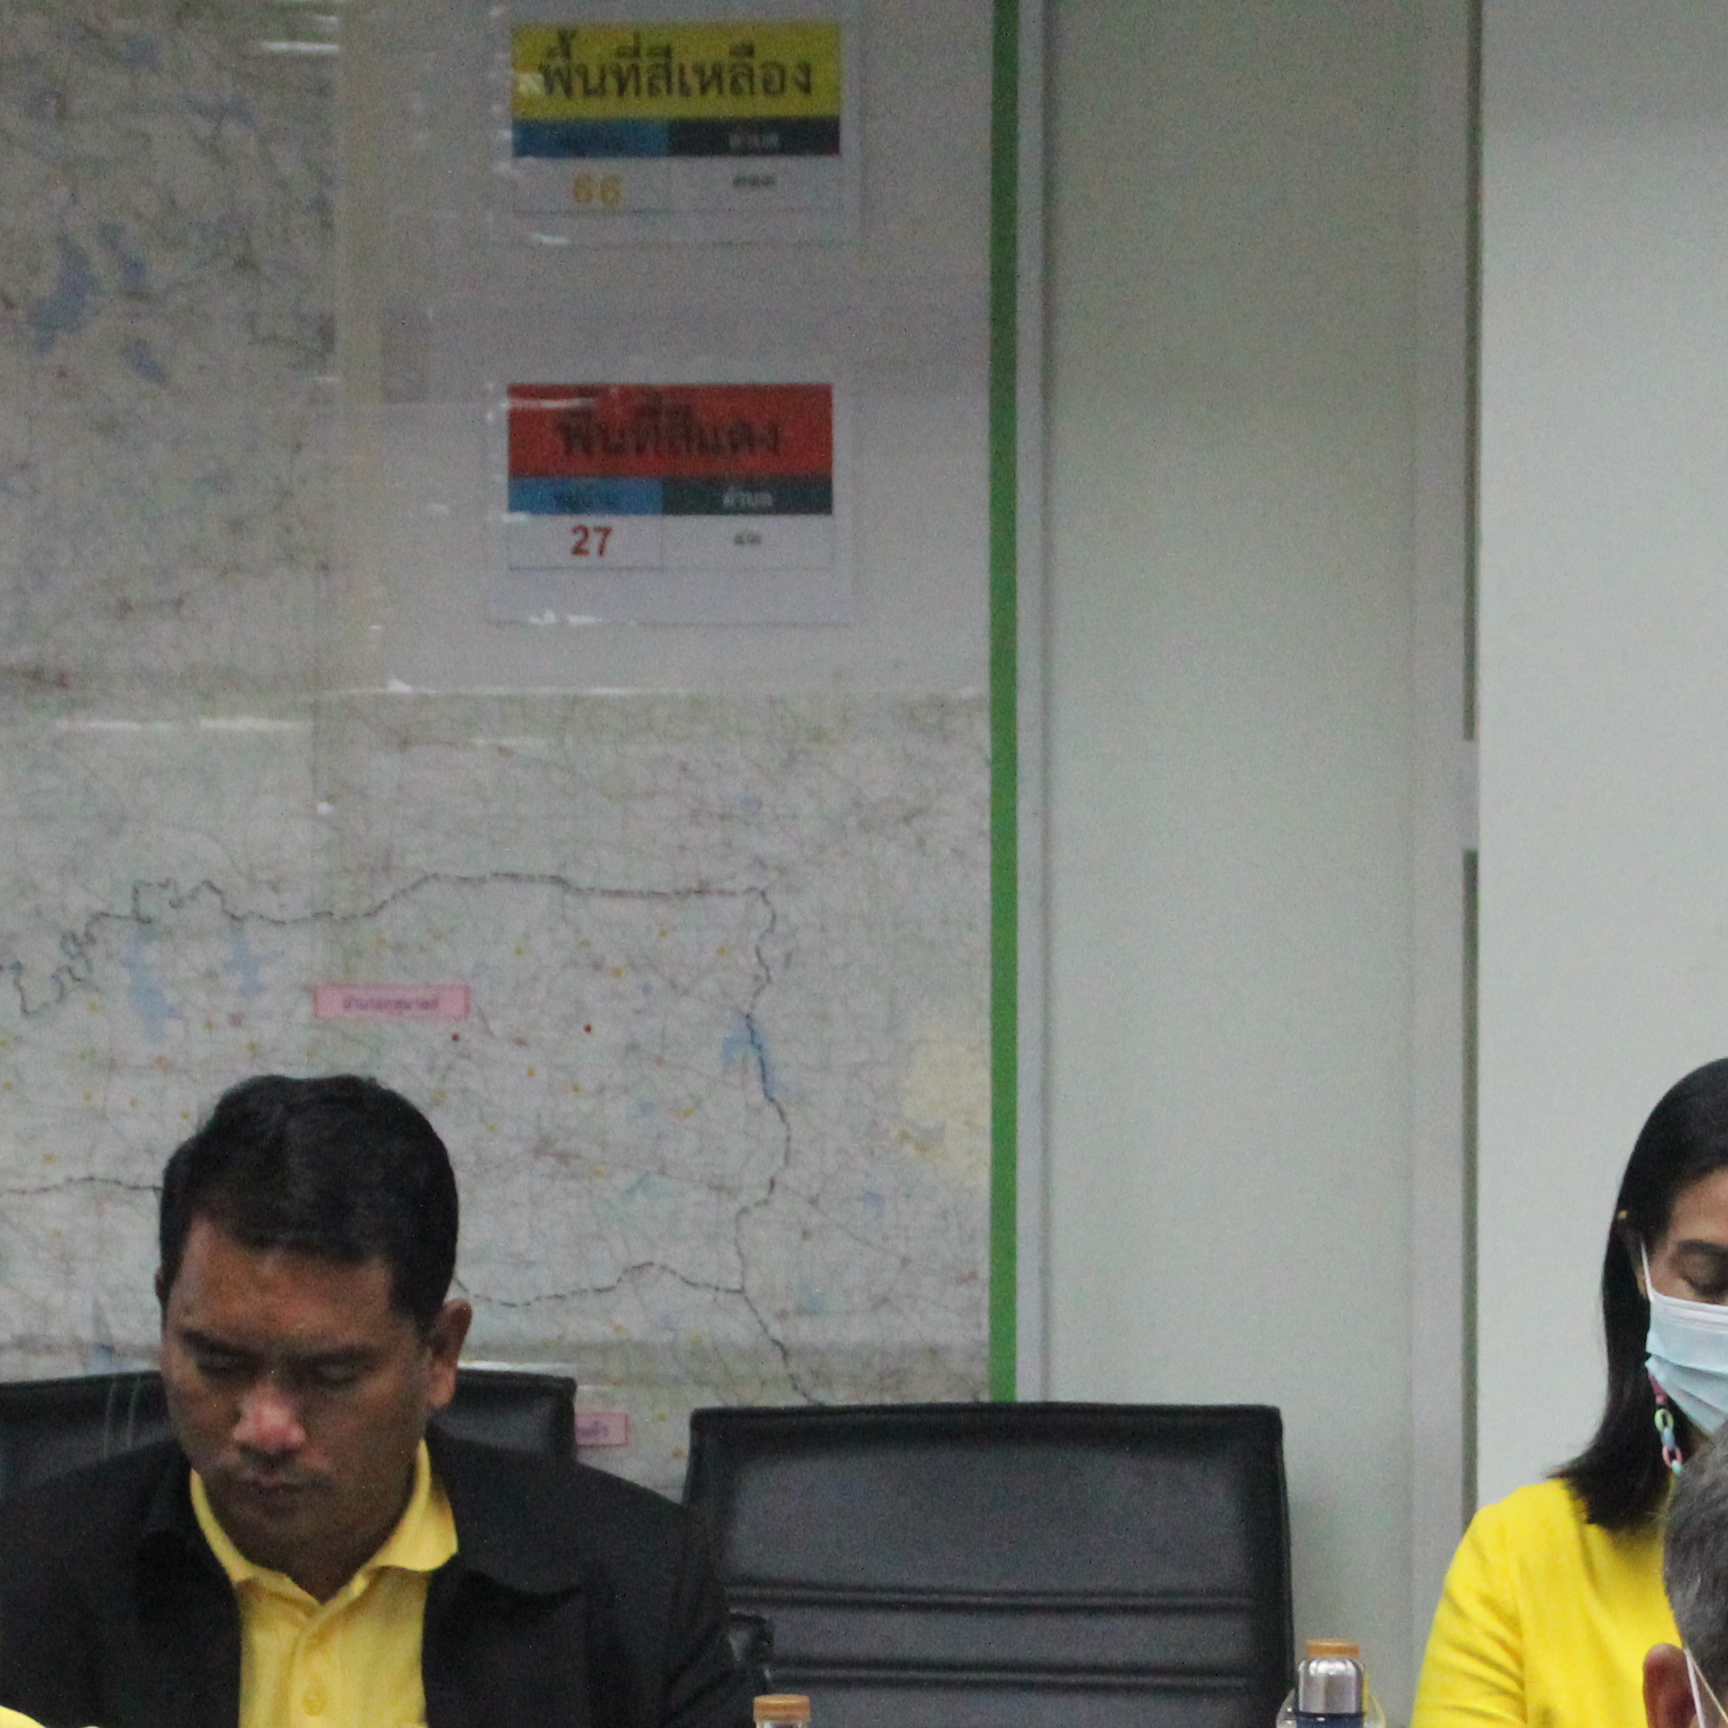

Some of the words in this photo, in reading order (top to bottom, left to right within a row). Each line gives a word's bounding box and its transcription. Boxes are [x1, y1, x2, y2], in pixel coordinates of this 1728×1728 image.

[538, 28, 813, 98] พื้นที่สีเหลือง
[572, 170, 623, 206] 66
[570, 525, 613, 557] 27
